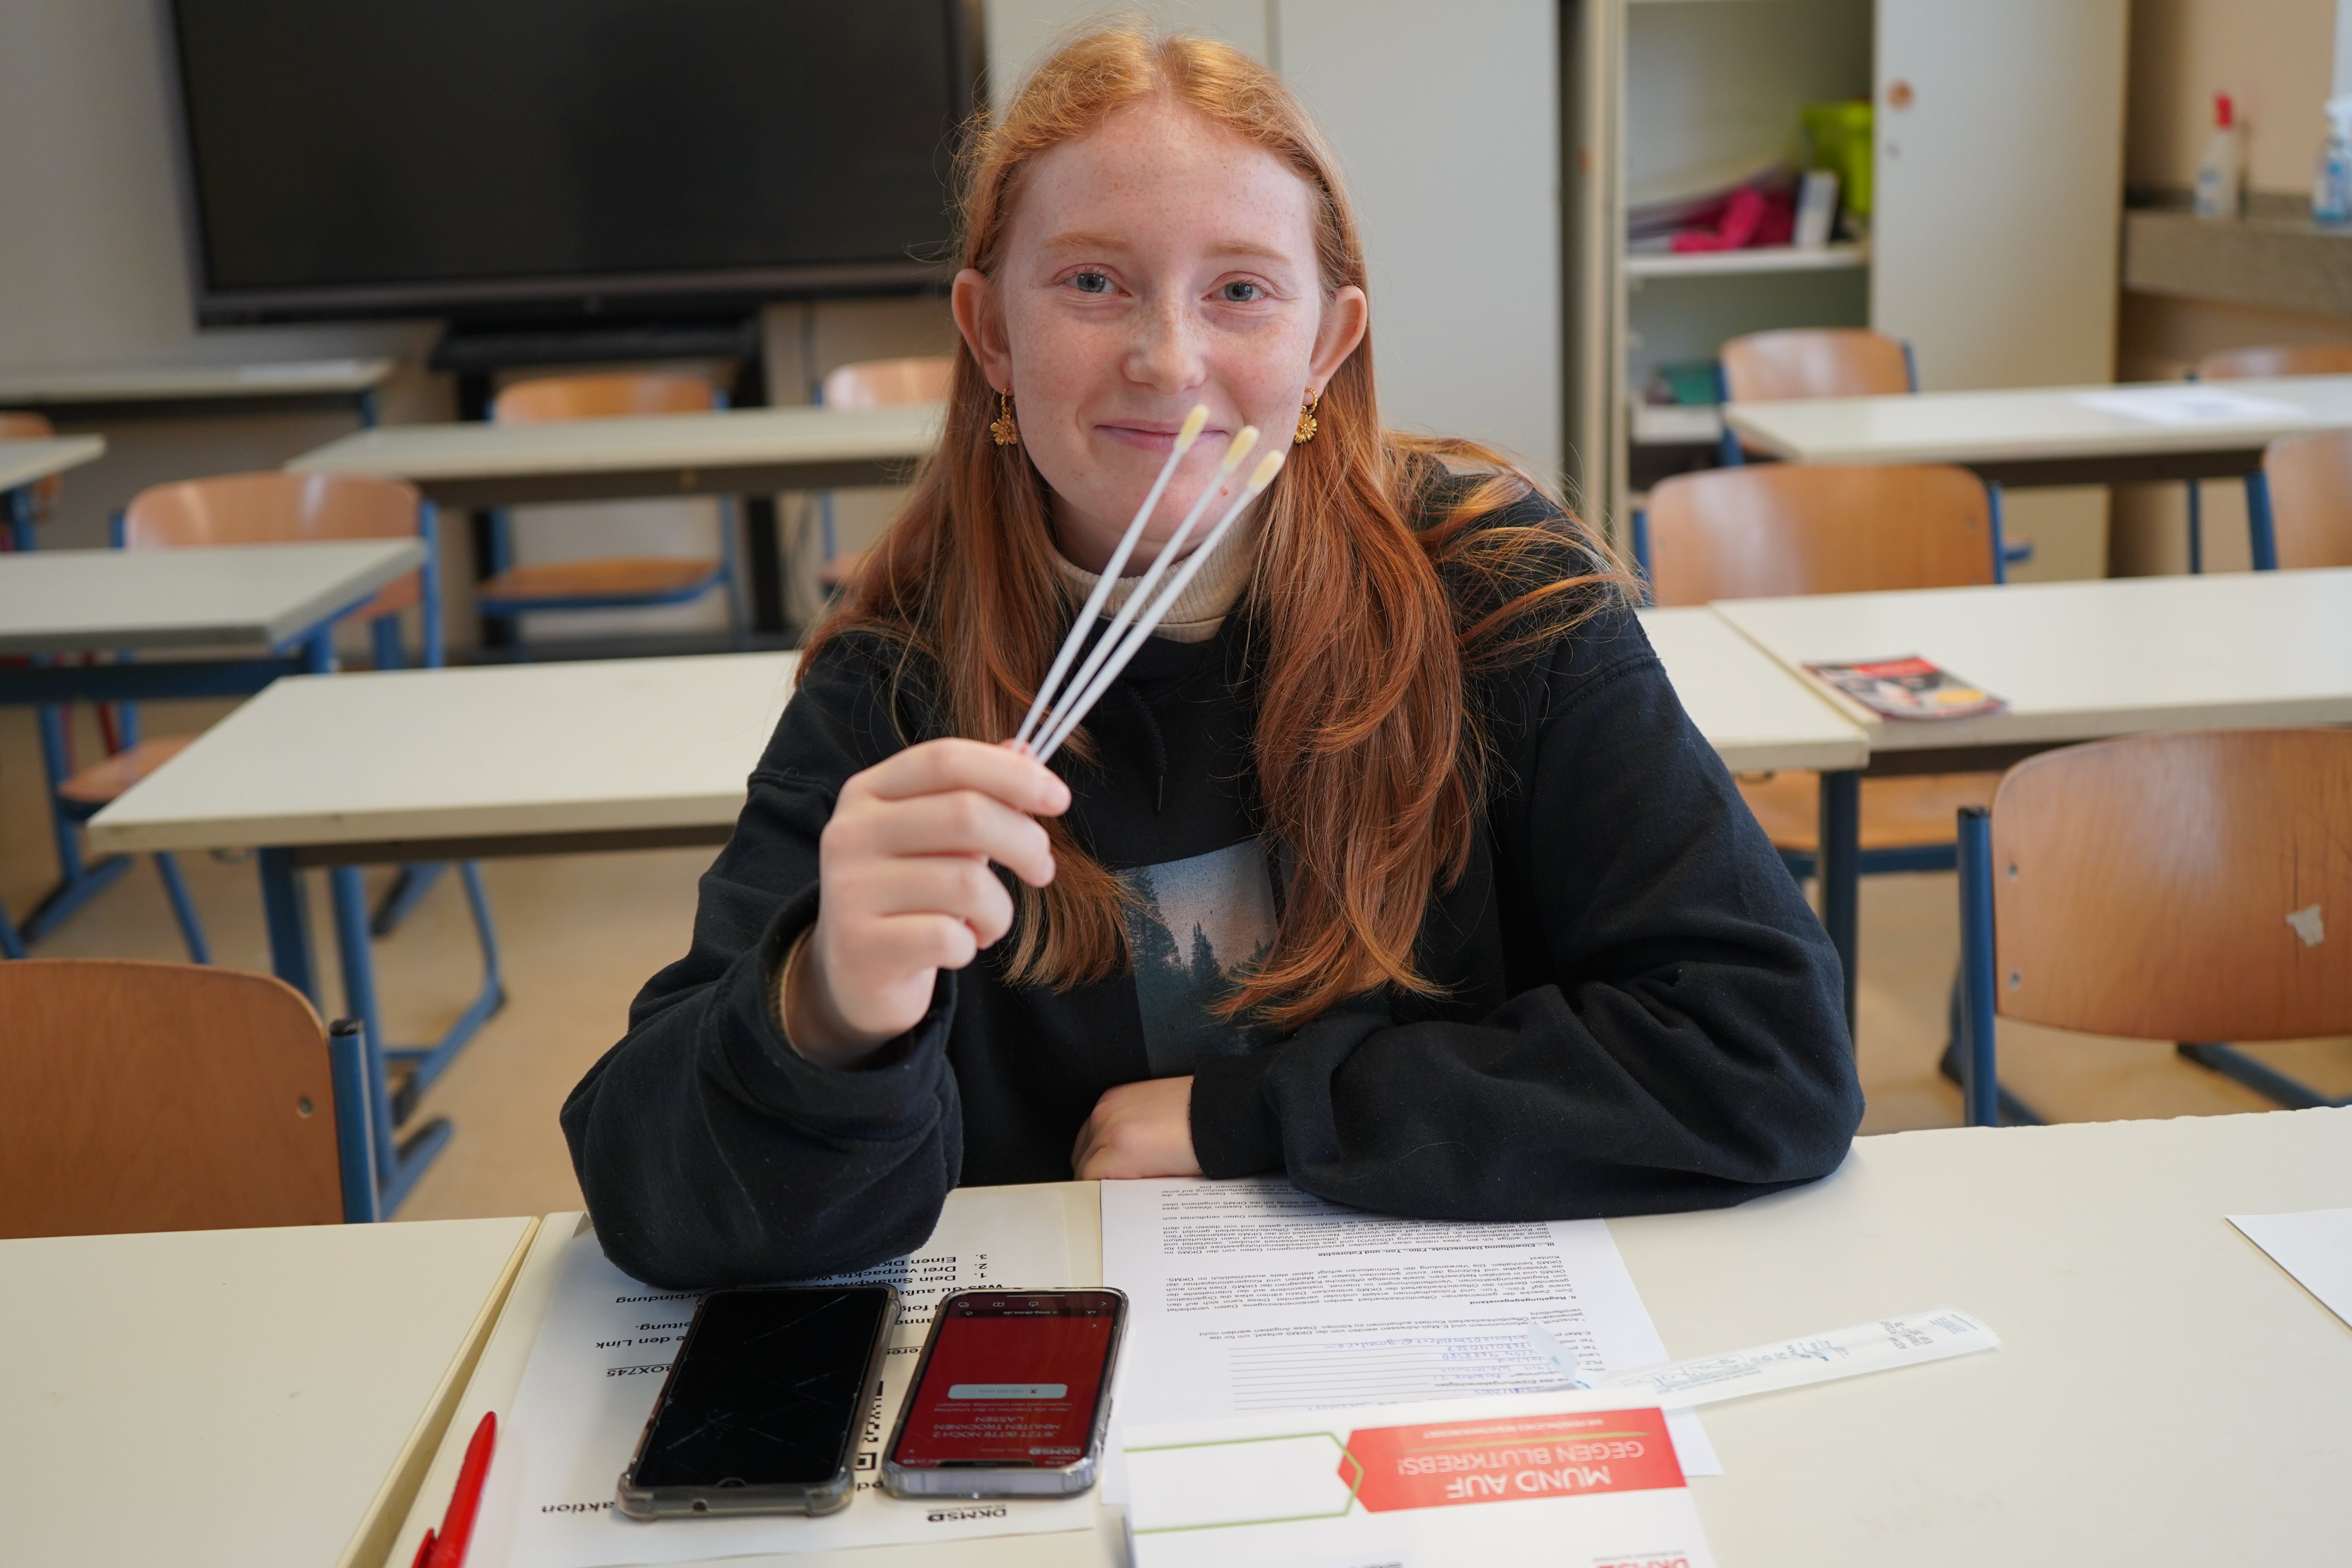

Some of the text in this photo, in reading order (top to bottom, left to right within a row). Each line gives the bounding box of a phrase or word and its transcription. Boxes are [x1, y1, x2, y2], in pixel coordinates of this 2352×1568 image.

[911, 1256, 956, 1265] Einen
[838, 1269, 918, 1279] verpackte
[595, 1339, 632, 1349] Link
[1397, 1440, 1644, 1475] GEGEN BLUTKREBS!
[1446, 1465, 1612, 1499] MUND AUF
[947, 1509, 1007, 1523] DKMS
